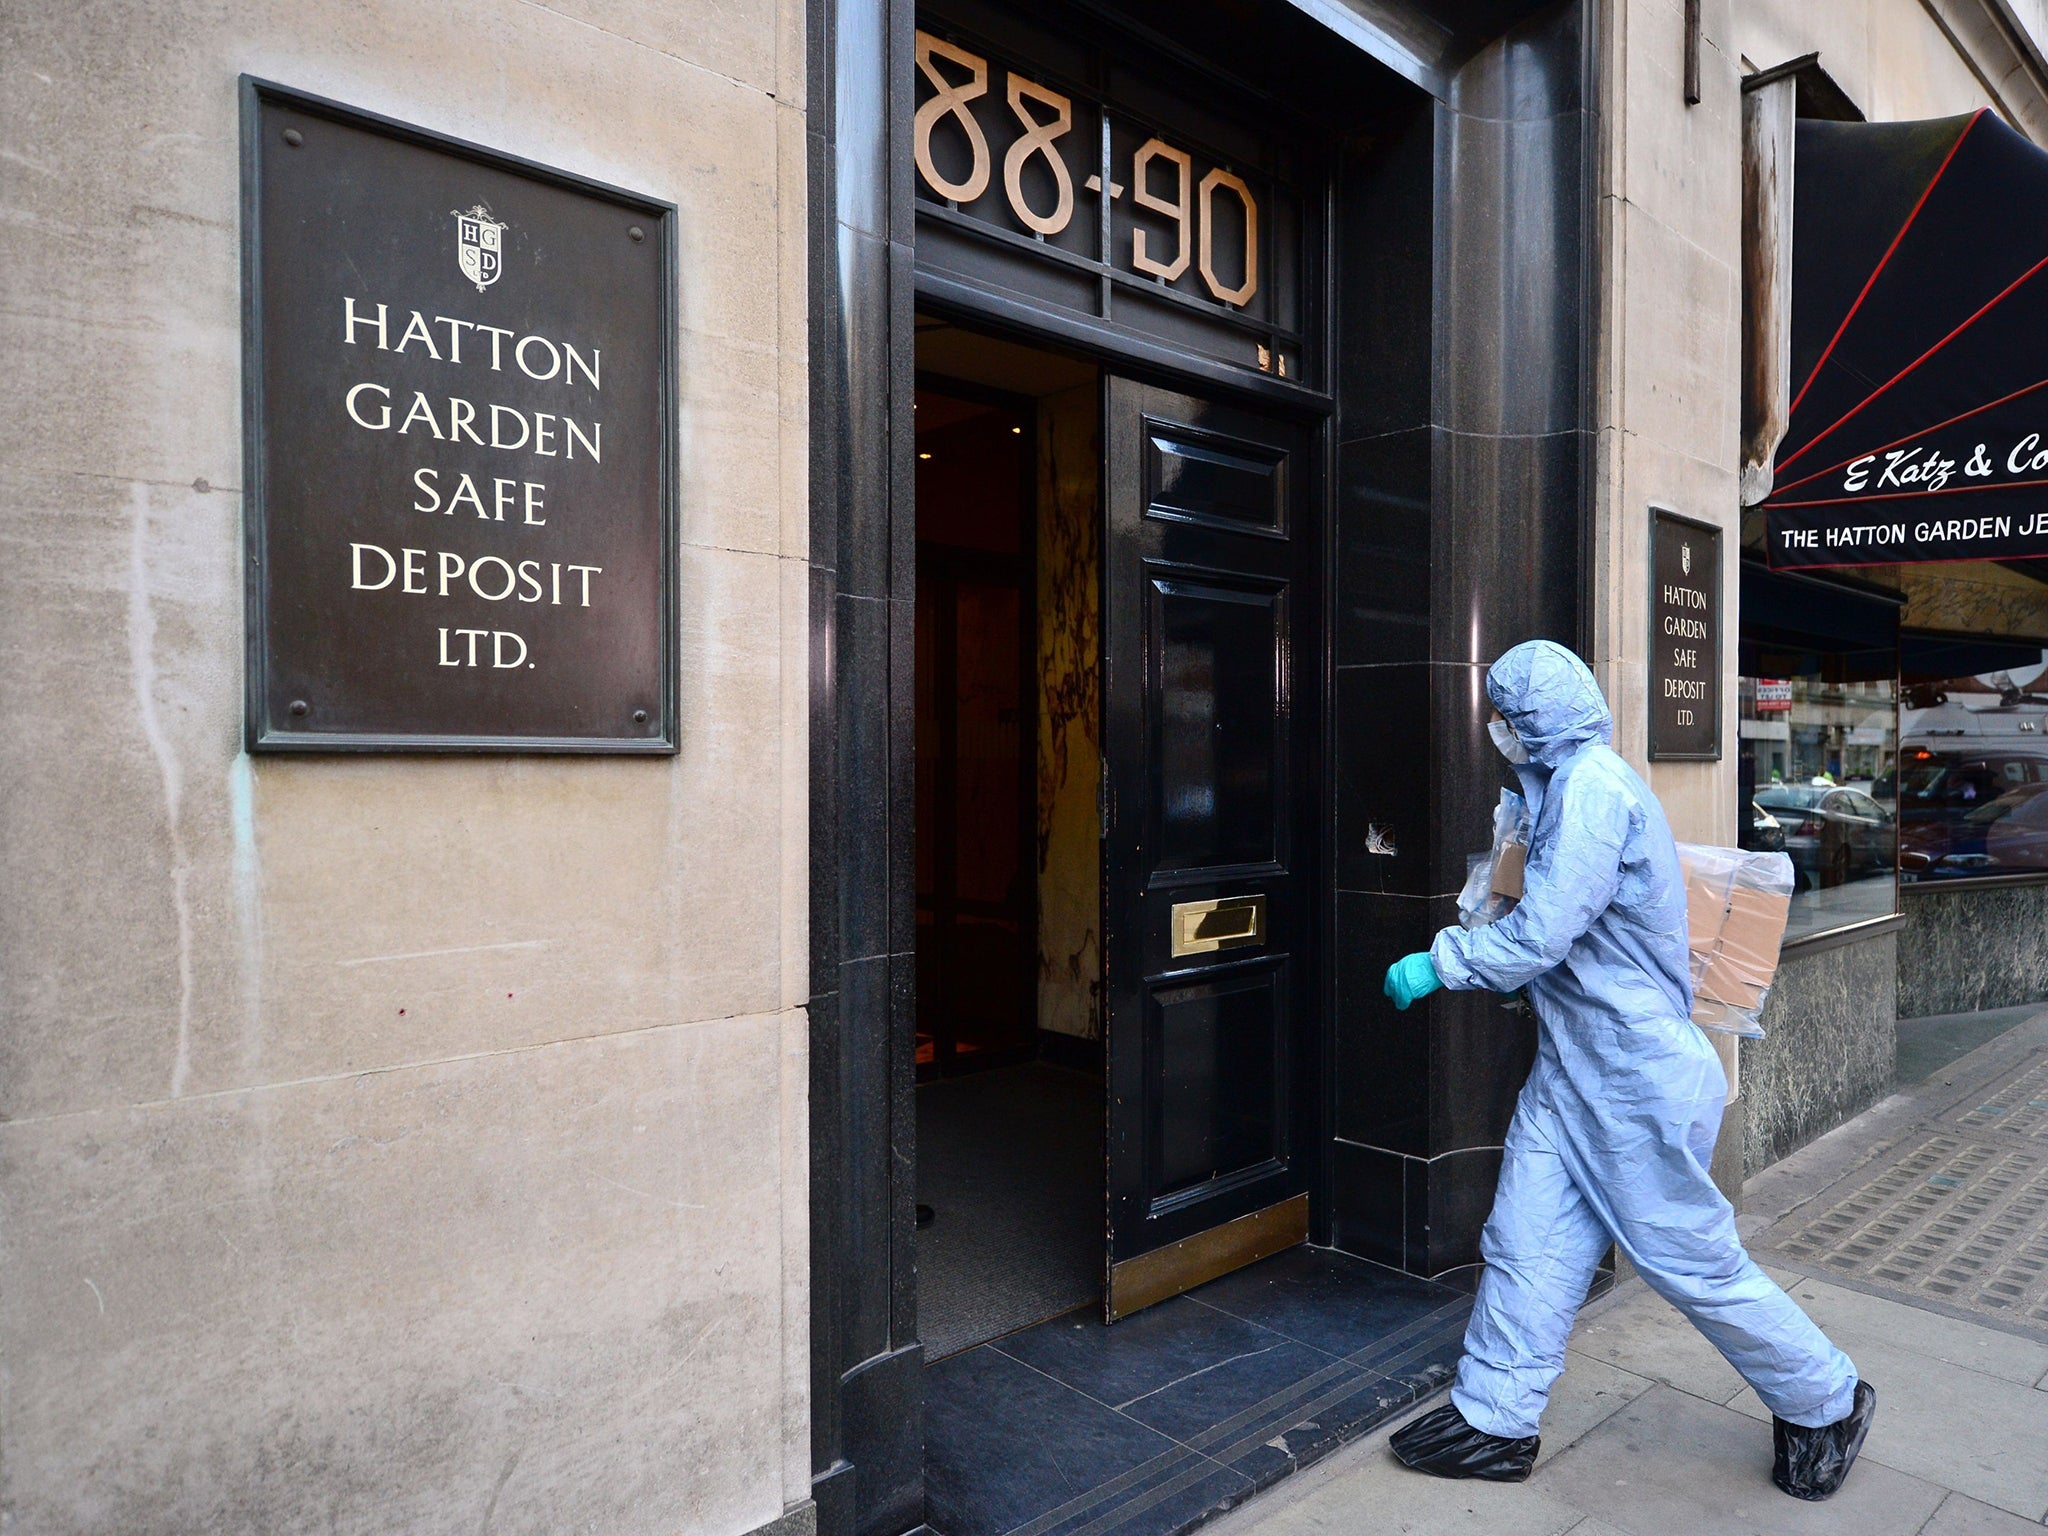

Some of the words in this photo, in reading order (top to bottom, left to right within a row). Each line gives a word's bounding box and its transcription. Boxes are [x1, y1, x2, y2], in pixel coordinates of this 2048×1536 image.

[914, 29, 1257, 307] 88-90
[343, 296, 601, 391] HATTON
[345, 382, 602, 464] GARDEN
[1843, 455, 1876, 492] E
[1877, 447, 1957, 492] Katz
[1964, 443, 1994, 477] &
[2007, 433, 2048, 474] Co
[413, 467, 547, 527] SAFE
[1781, 529, 1819, 549] THE
[1826, 523, 1906, 547] HATTON
[1914, 515, 2012, 543] GARDEN
[349, 542, 603, 608] DEPOSIT
[1664, 584, 1707, 610] HATTON
[438, 627, 536, 670] LTD.
[1664, 615, 1707, 640] GARDEN
[1673, 647, 1697, 669] SAFE
[1664, 678, 1706, 700] DEPOSIT
[1677, 709, 1695, 726] LTD.
